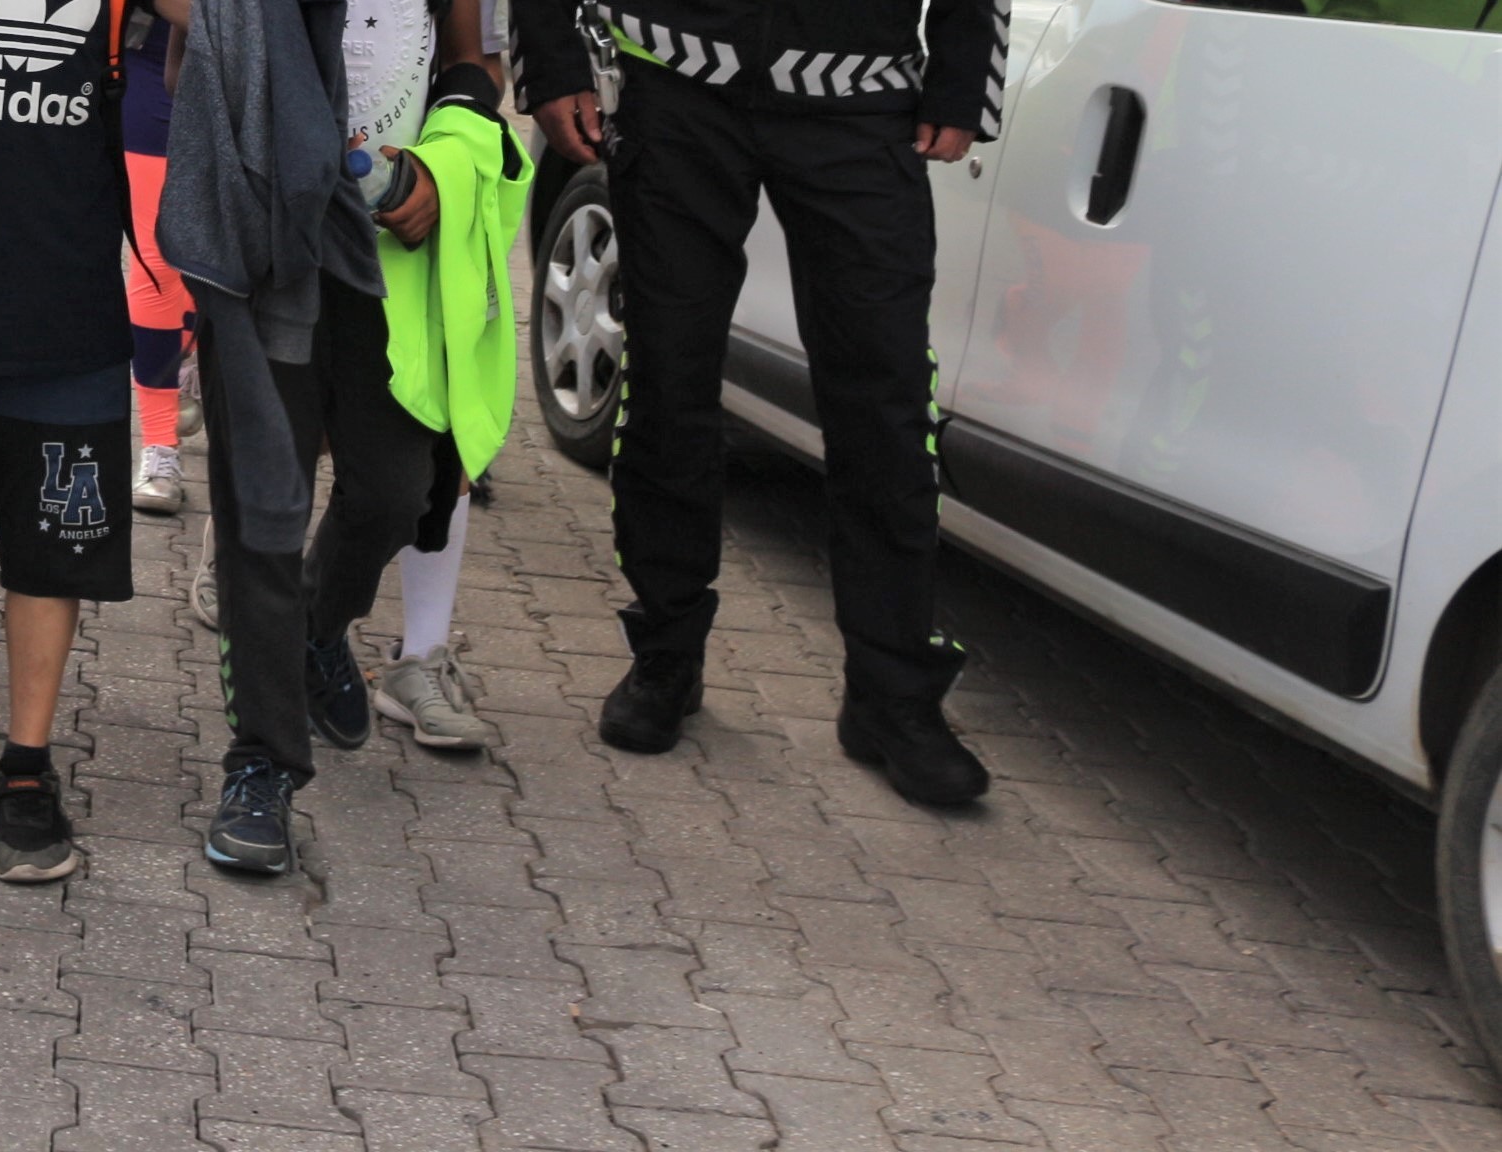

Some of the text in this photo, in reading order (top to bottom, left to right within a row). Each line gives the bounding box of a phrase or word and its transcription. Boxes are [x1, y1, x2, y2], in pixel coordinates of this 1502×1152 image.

[40, 442, 106, 526] LA
[39, 501, 60, 514] LOS
[58, 526, 110, 540] ANGELES
